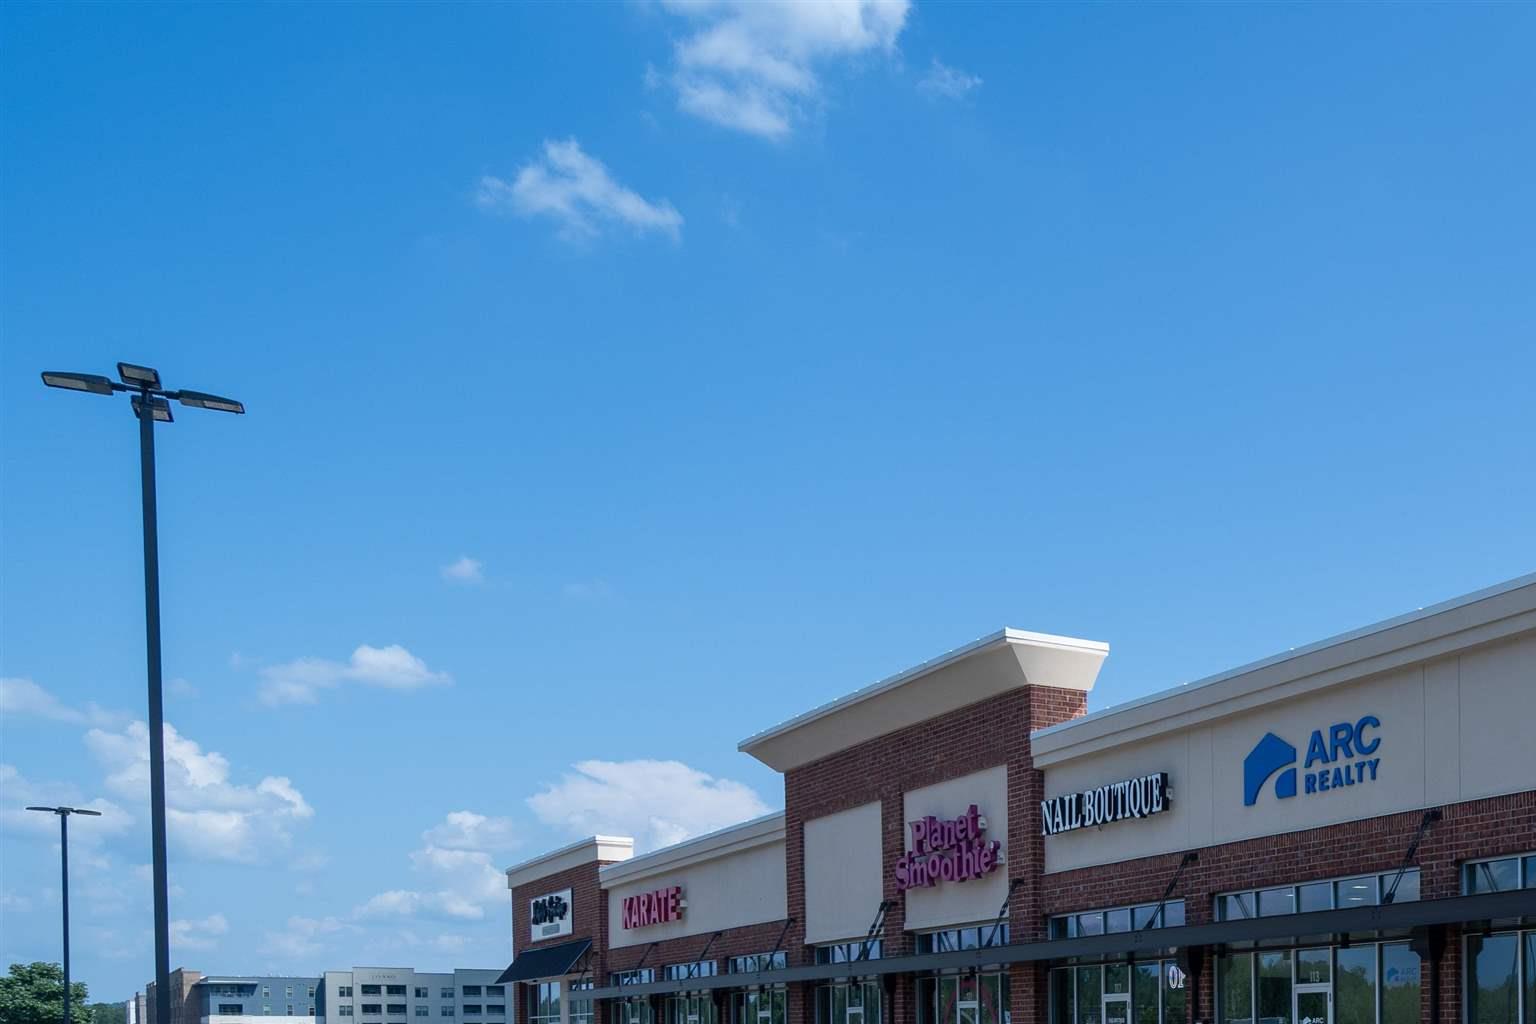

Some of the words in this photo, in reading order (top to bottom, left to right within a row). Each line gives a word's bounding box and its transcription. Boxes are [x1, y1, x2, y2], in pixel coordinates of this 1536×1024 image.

[1304, 715, 1381, 768] ARC
[1304, 757, 1380, 794] REALTY
[1041, 793, 1082, 836] NAIL
[1084, 773, 1165, 827] BOUTIQUE
[909, 804, 978, 857] Planet
[895, 841, 994, 891] Smoothie
[622, 886, 682, 930] KARATE
